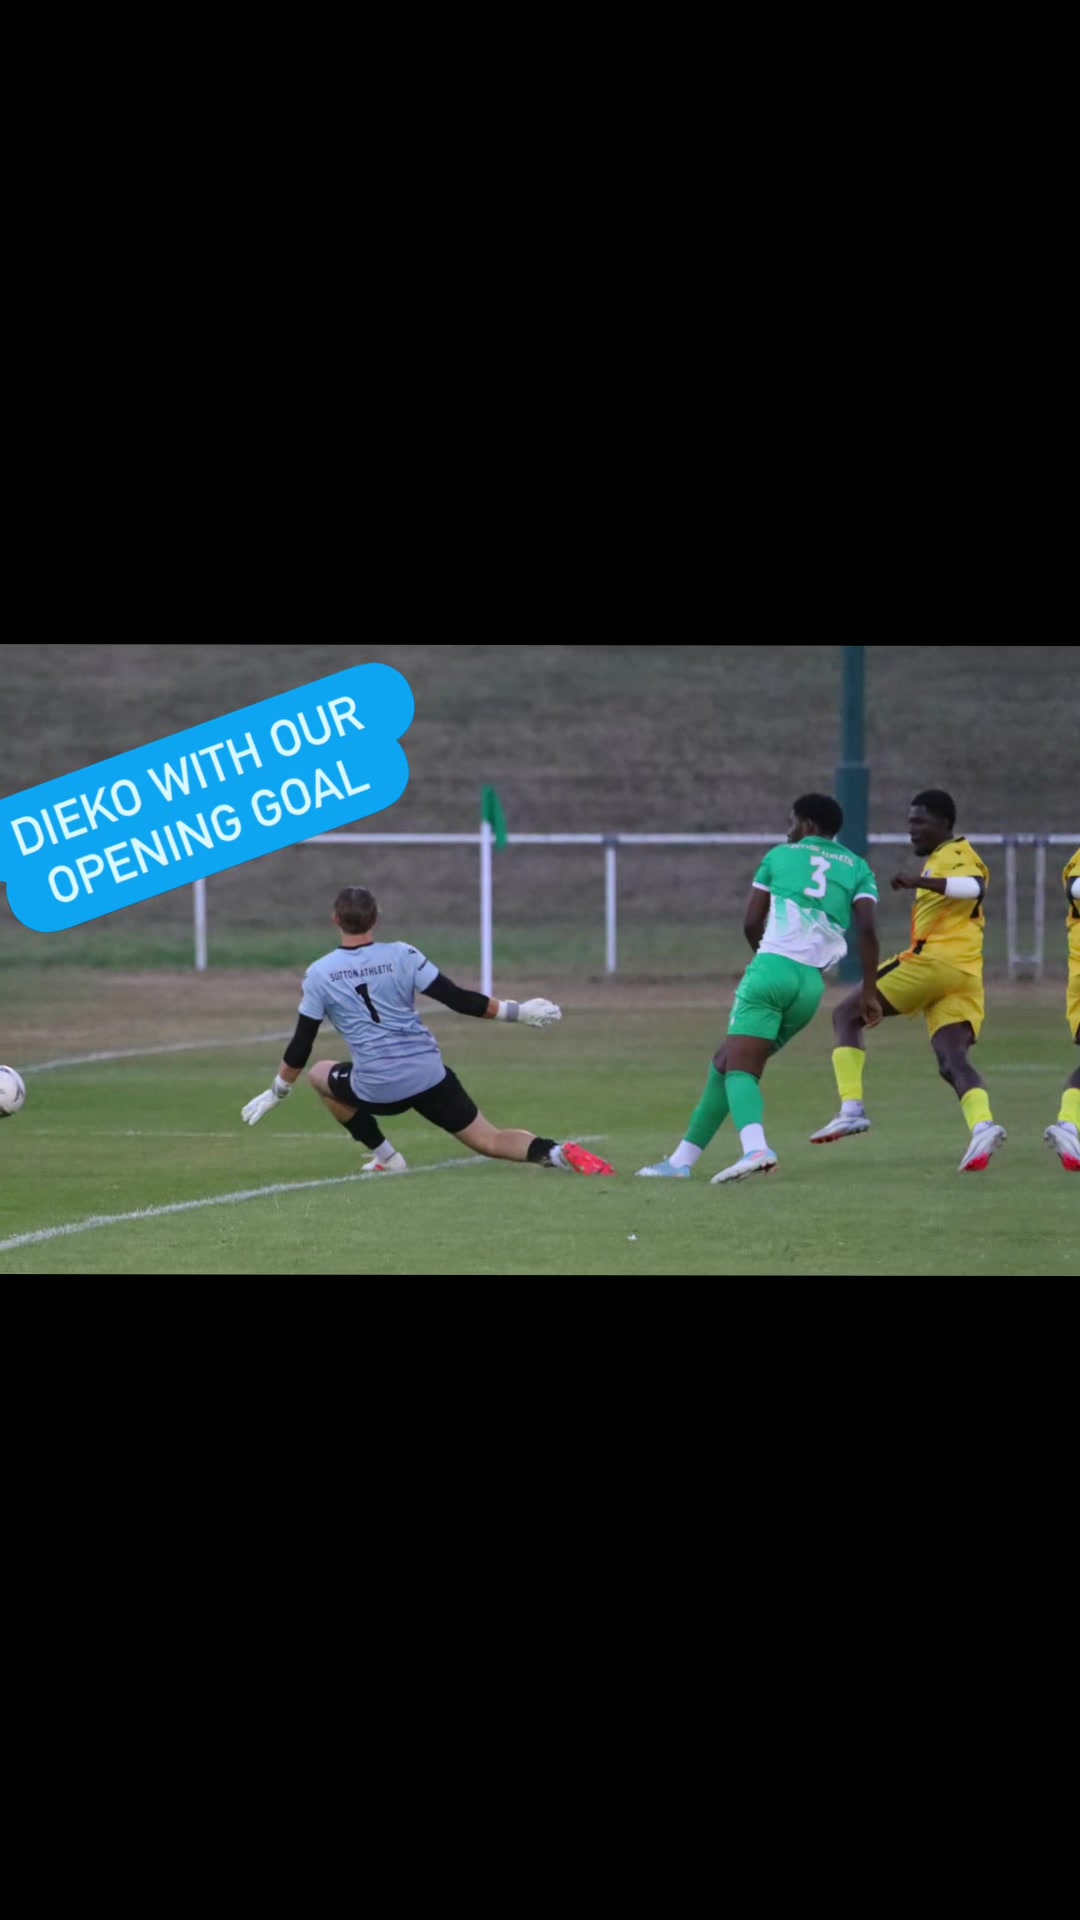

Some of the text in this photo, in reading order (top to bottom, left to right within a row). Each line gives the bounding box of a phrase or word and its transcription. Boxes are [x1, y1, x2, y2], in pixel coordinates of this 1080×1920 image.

[803, 855, 831, 898] 3
[329, 963, 393, 982] SUTTON ATHLETIC
[354, 983, 381, 1023] 1
